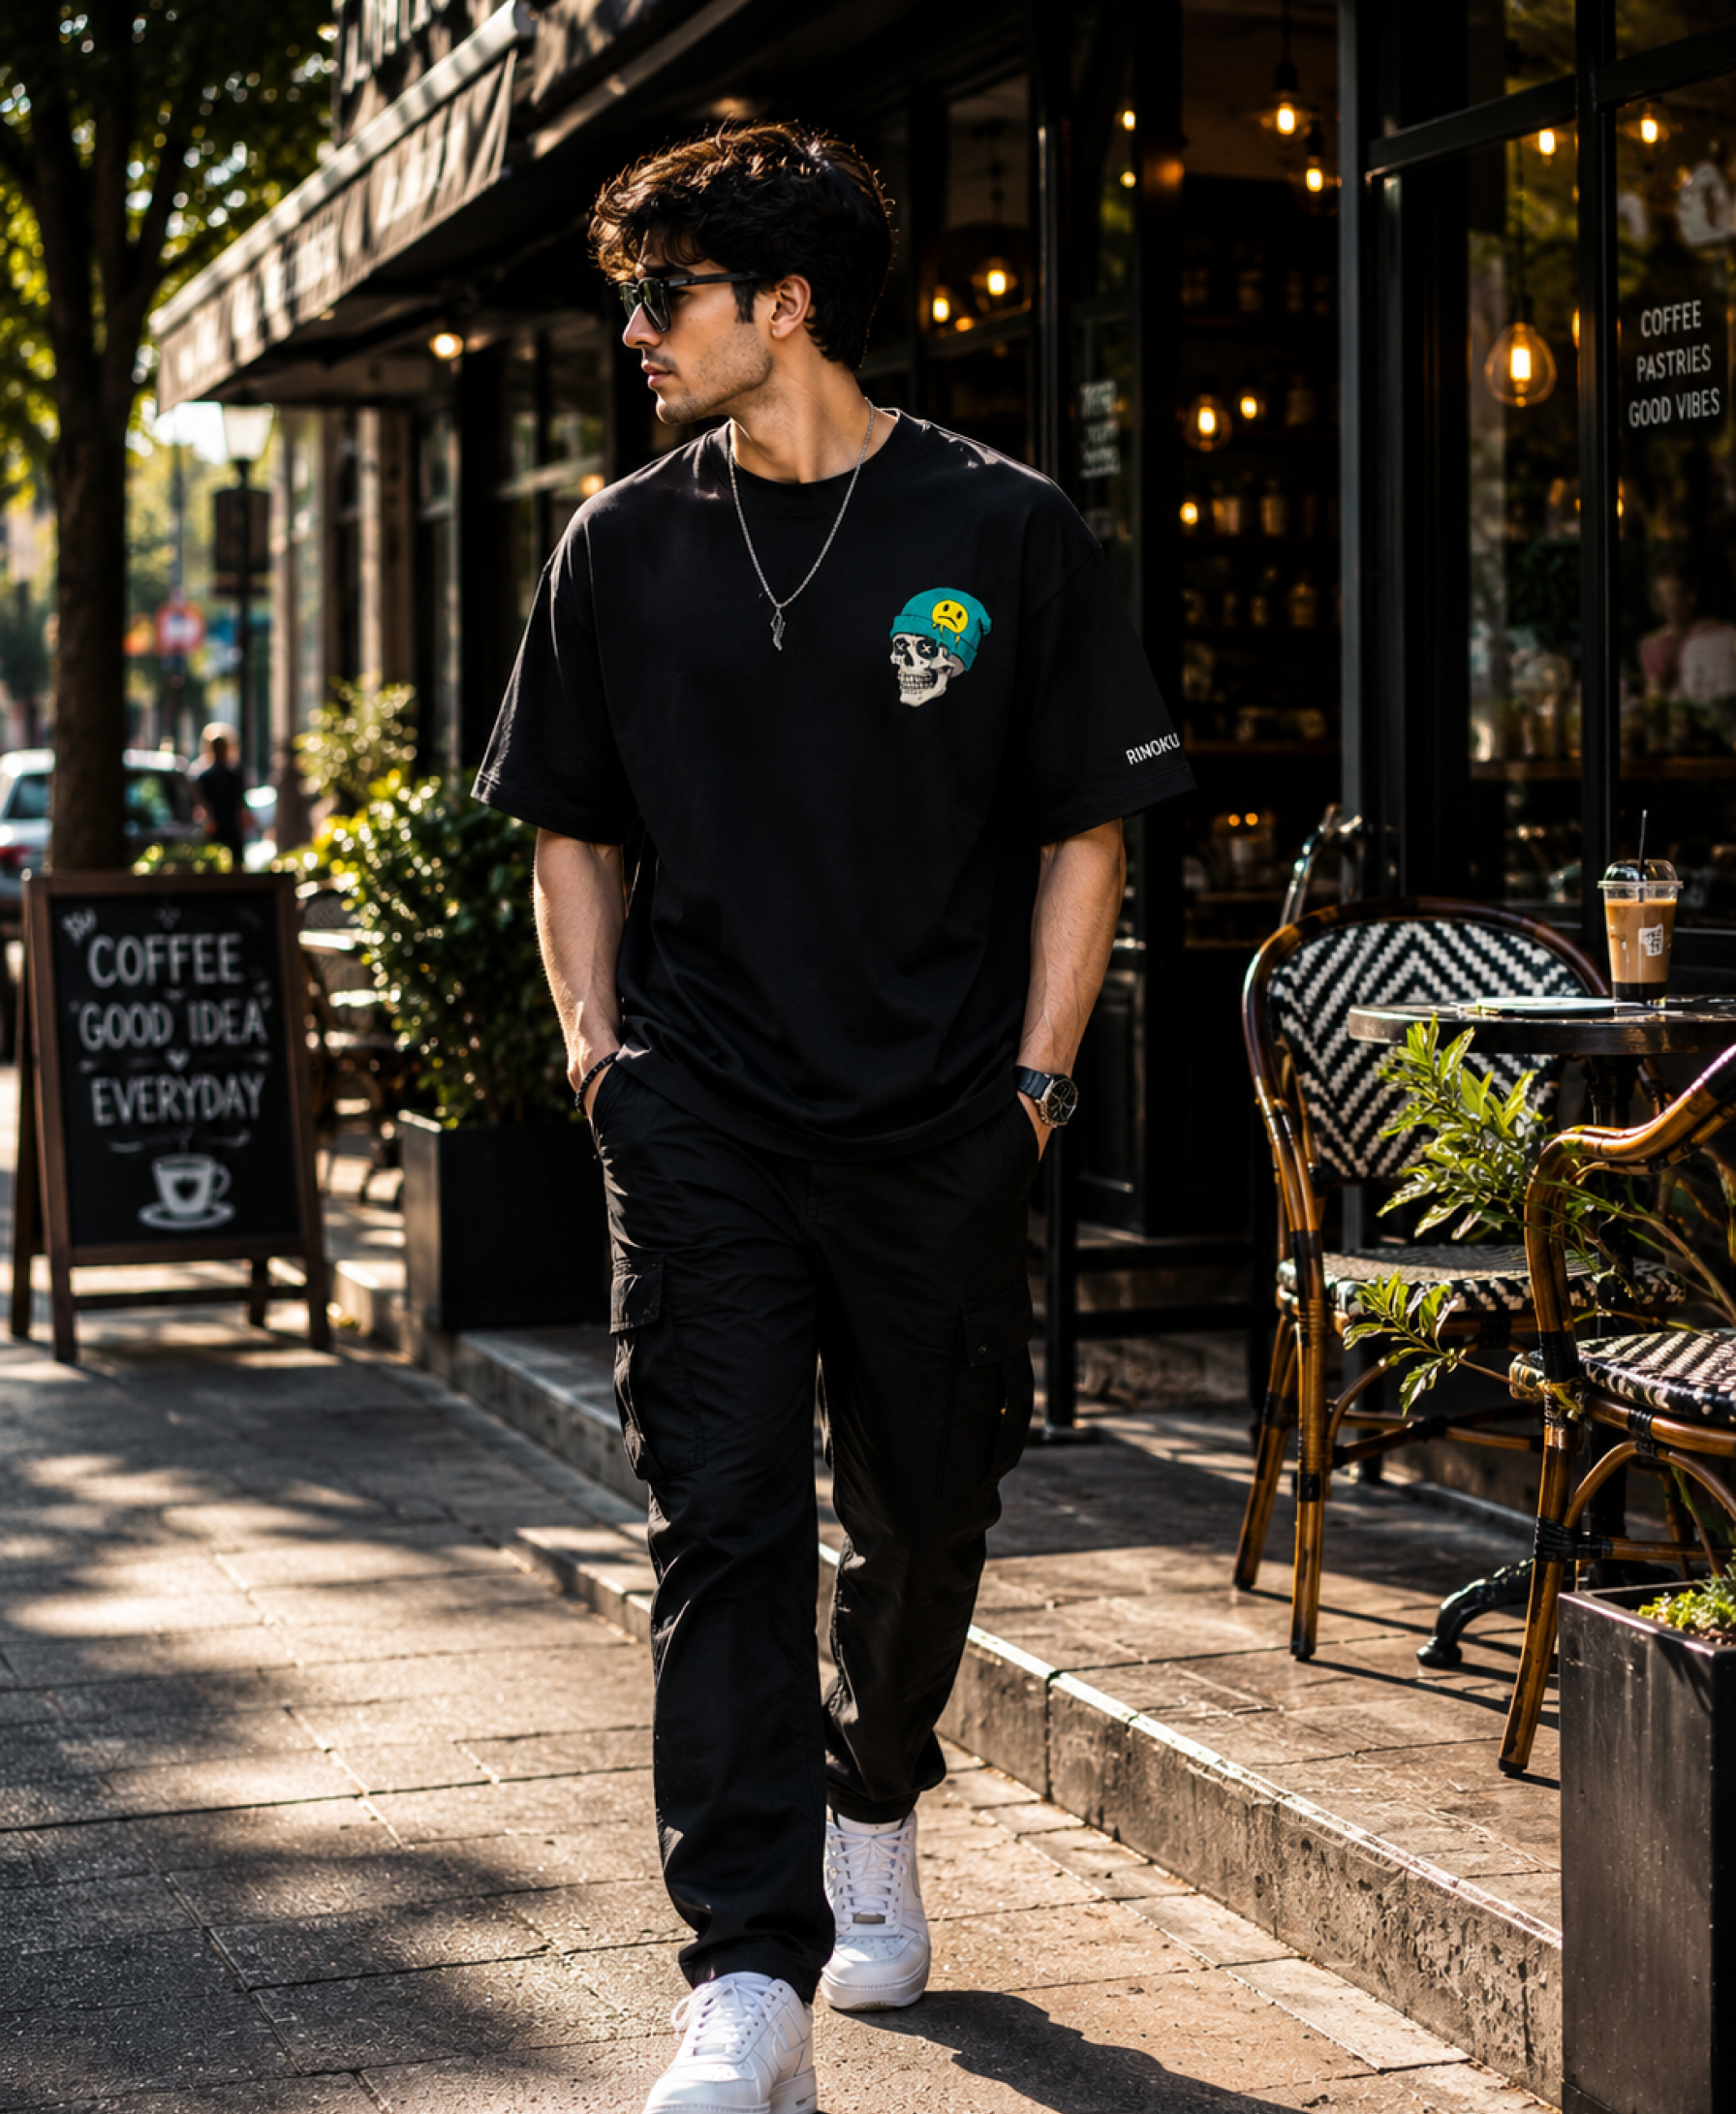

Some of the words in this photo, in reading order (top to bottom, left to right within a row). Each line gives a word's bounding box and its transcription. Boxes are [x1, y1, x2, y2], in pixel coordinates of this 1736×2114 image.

[1641, 299, 1702, 338] COFFEE
[1636, 343, 1712, 383] PASTRIES
[1628, 395, 1672, 428] GOOD
[1676, 388, 1720, 420] VIBES
[1126, 732, 1181, 765] RINOKU
[87, 933, 242, 988] COFFEE
[78, 1001, 174, 1050] GOOD
[187, 999, 268, 1045] IDEA
[90, 1072, 265, 1127] EVERYDAY
